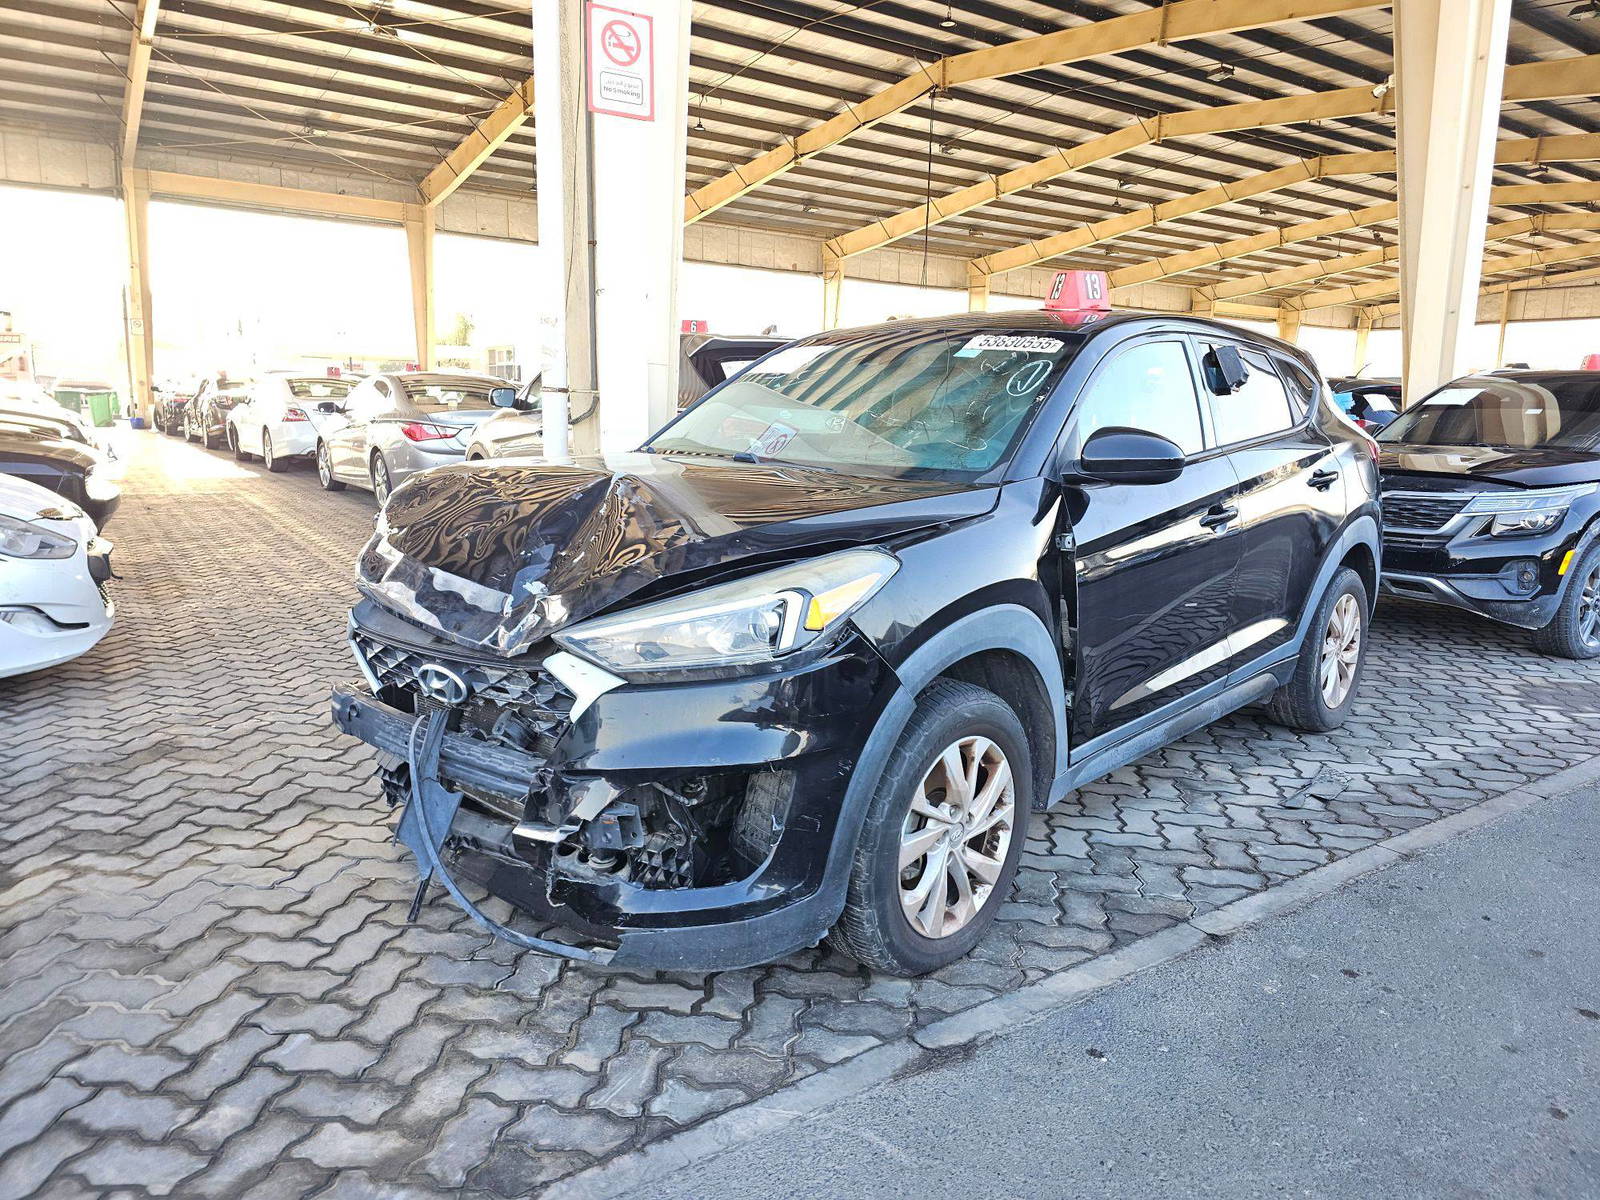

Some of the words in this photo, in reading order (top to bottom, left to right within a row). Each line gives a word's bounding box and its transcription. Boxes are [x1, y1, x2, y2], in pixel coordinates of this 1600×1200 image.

[1050, 273, 1067, 300] 13
[1085, 272, 1102, 300] 13
[691, 321, 697, 333] 6
